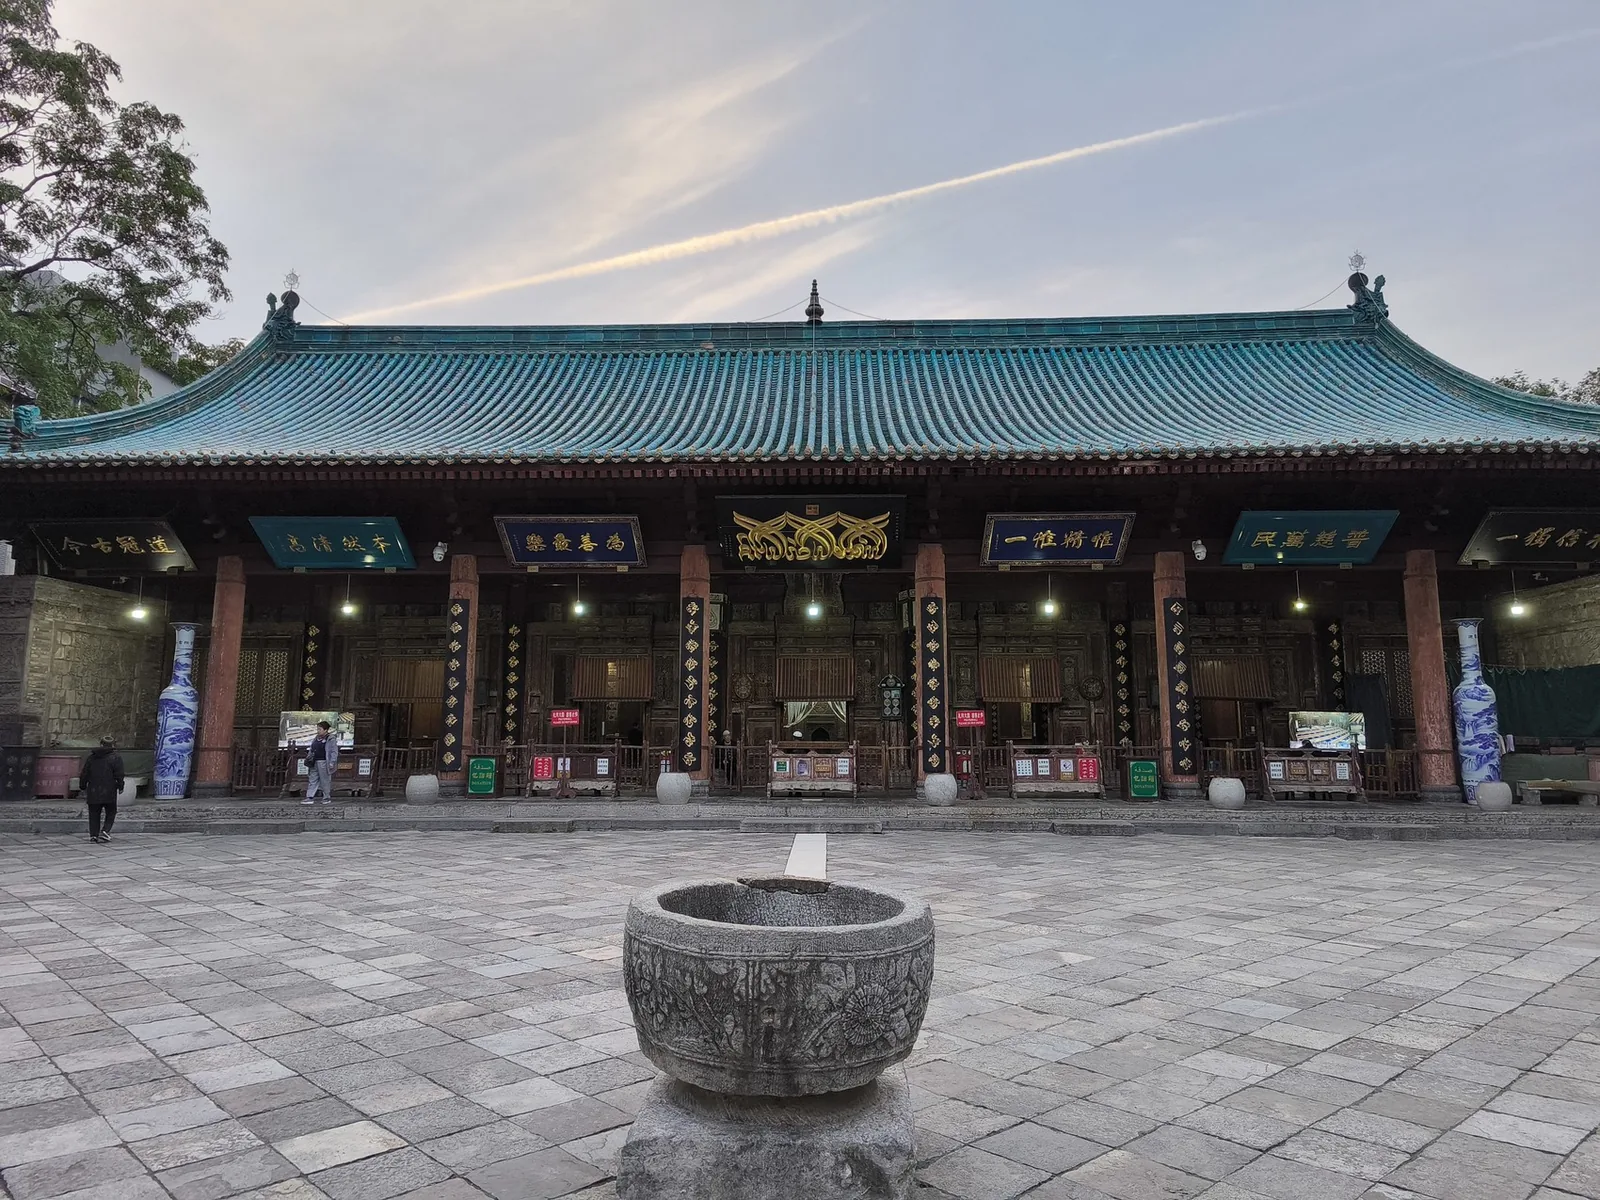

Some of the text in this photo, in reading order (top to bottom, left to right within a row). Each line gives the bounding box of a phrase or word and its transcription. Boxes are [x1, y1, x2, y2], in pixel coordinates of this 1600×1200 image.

[63, 534, 177, 556] 道冠古今
[1004, 529, 1114, 549] 惟精惟一
